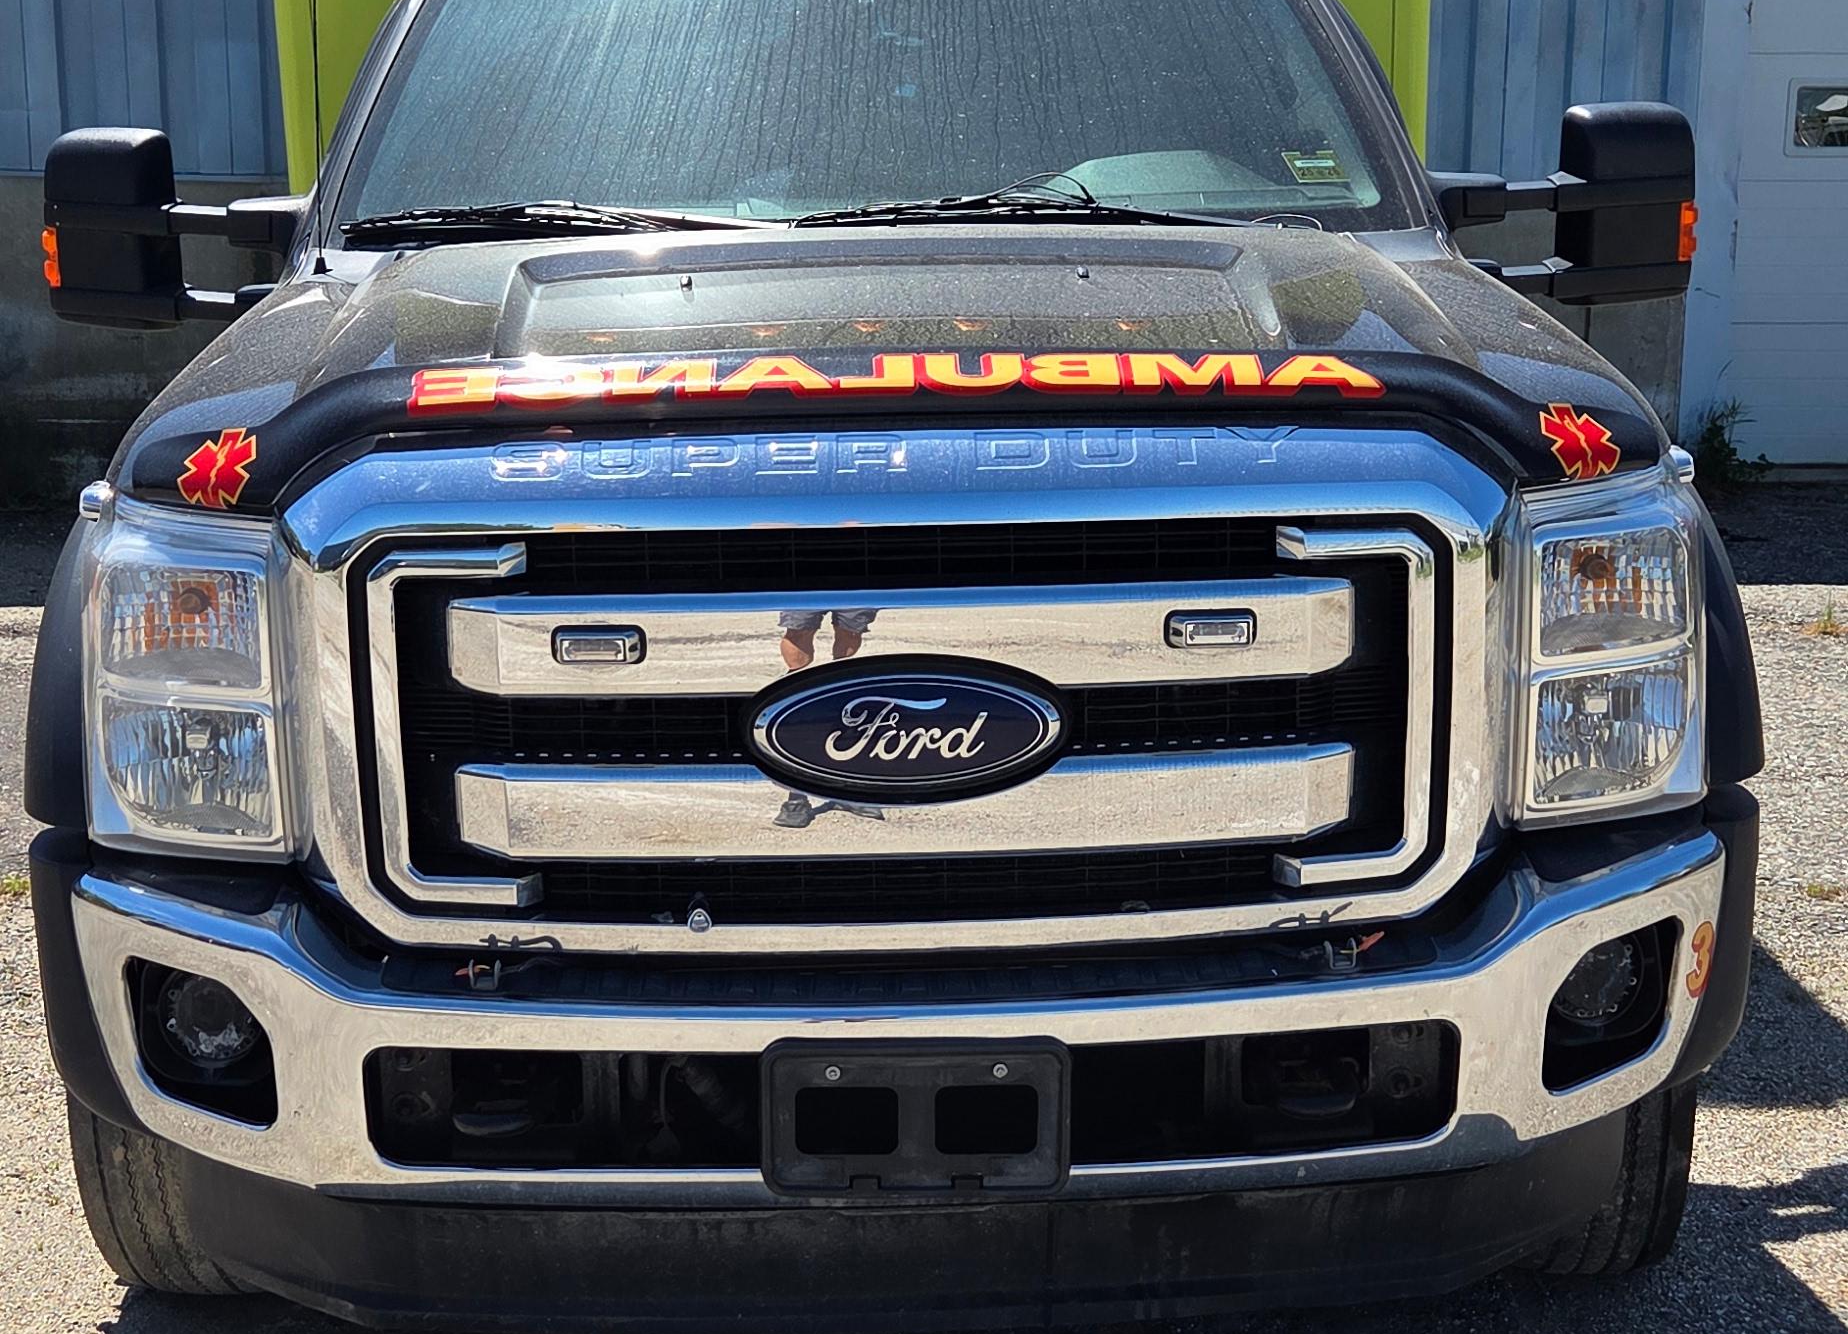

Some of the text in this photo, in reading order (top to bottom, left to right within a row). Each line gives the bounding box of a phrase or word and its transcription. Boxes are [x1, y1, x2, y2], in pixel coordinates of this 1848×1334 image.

[490, 425, 1300, 482] SUPER DUTY
[825, 696, 989, 761] Ford
[1686, 920, 1715, 999] 3
